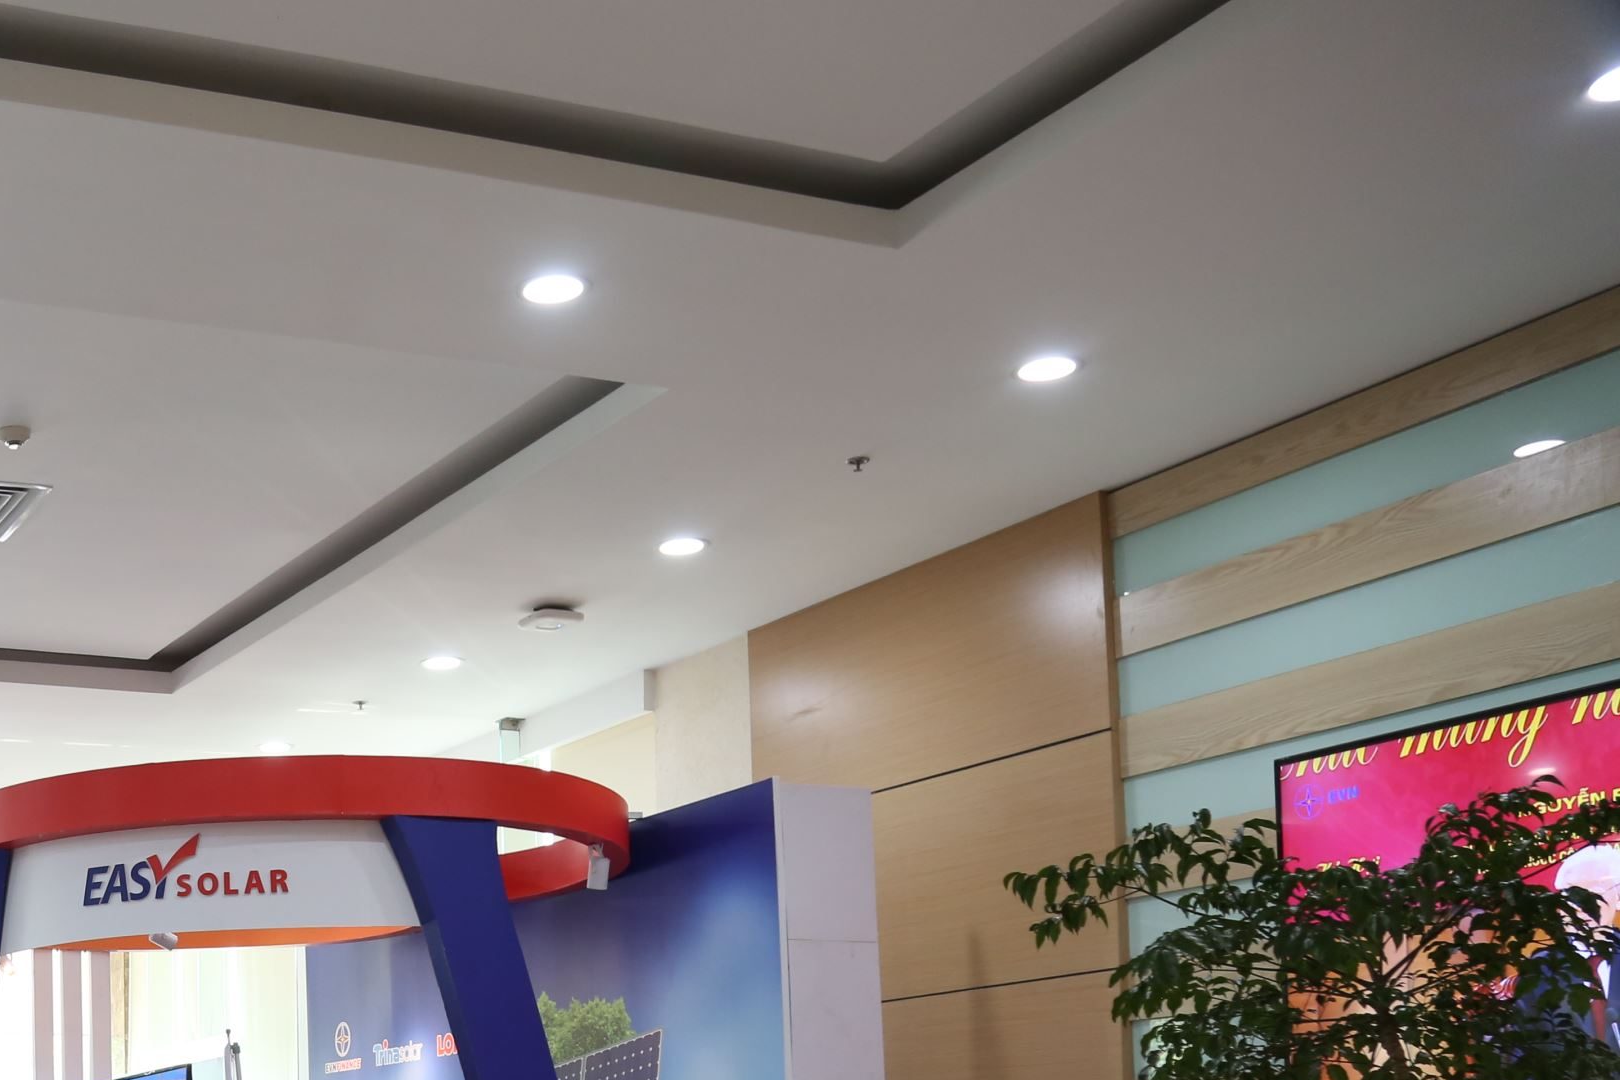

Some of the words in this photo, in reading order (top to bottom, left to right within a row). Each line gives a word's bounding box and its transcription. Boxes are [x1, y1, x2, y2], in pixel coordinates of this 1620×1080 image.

[1328, 785, 1360, 805] EVN
[1517, 787, 1606, 818] GUYỄN
[83, 833, 201, 907] EASY
[176, 869, 290, 897] SOLAR
[436, 1032, 458, 1057] LO
